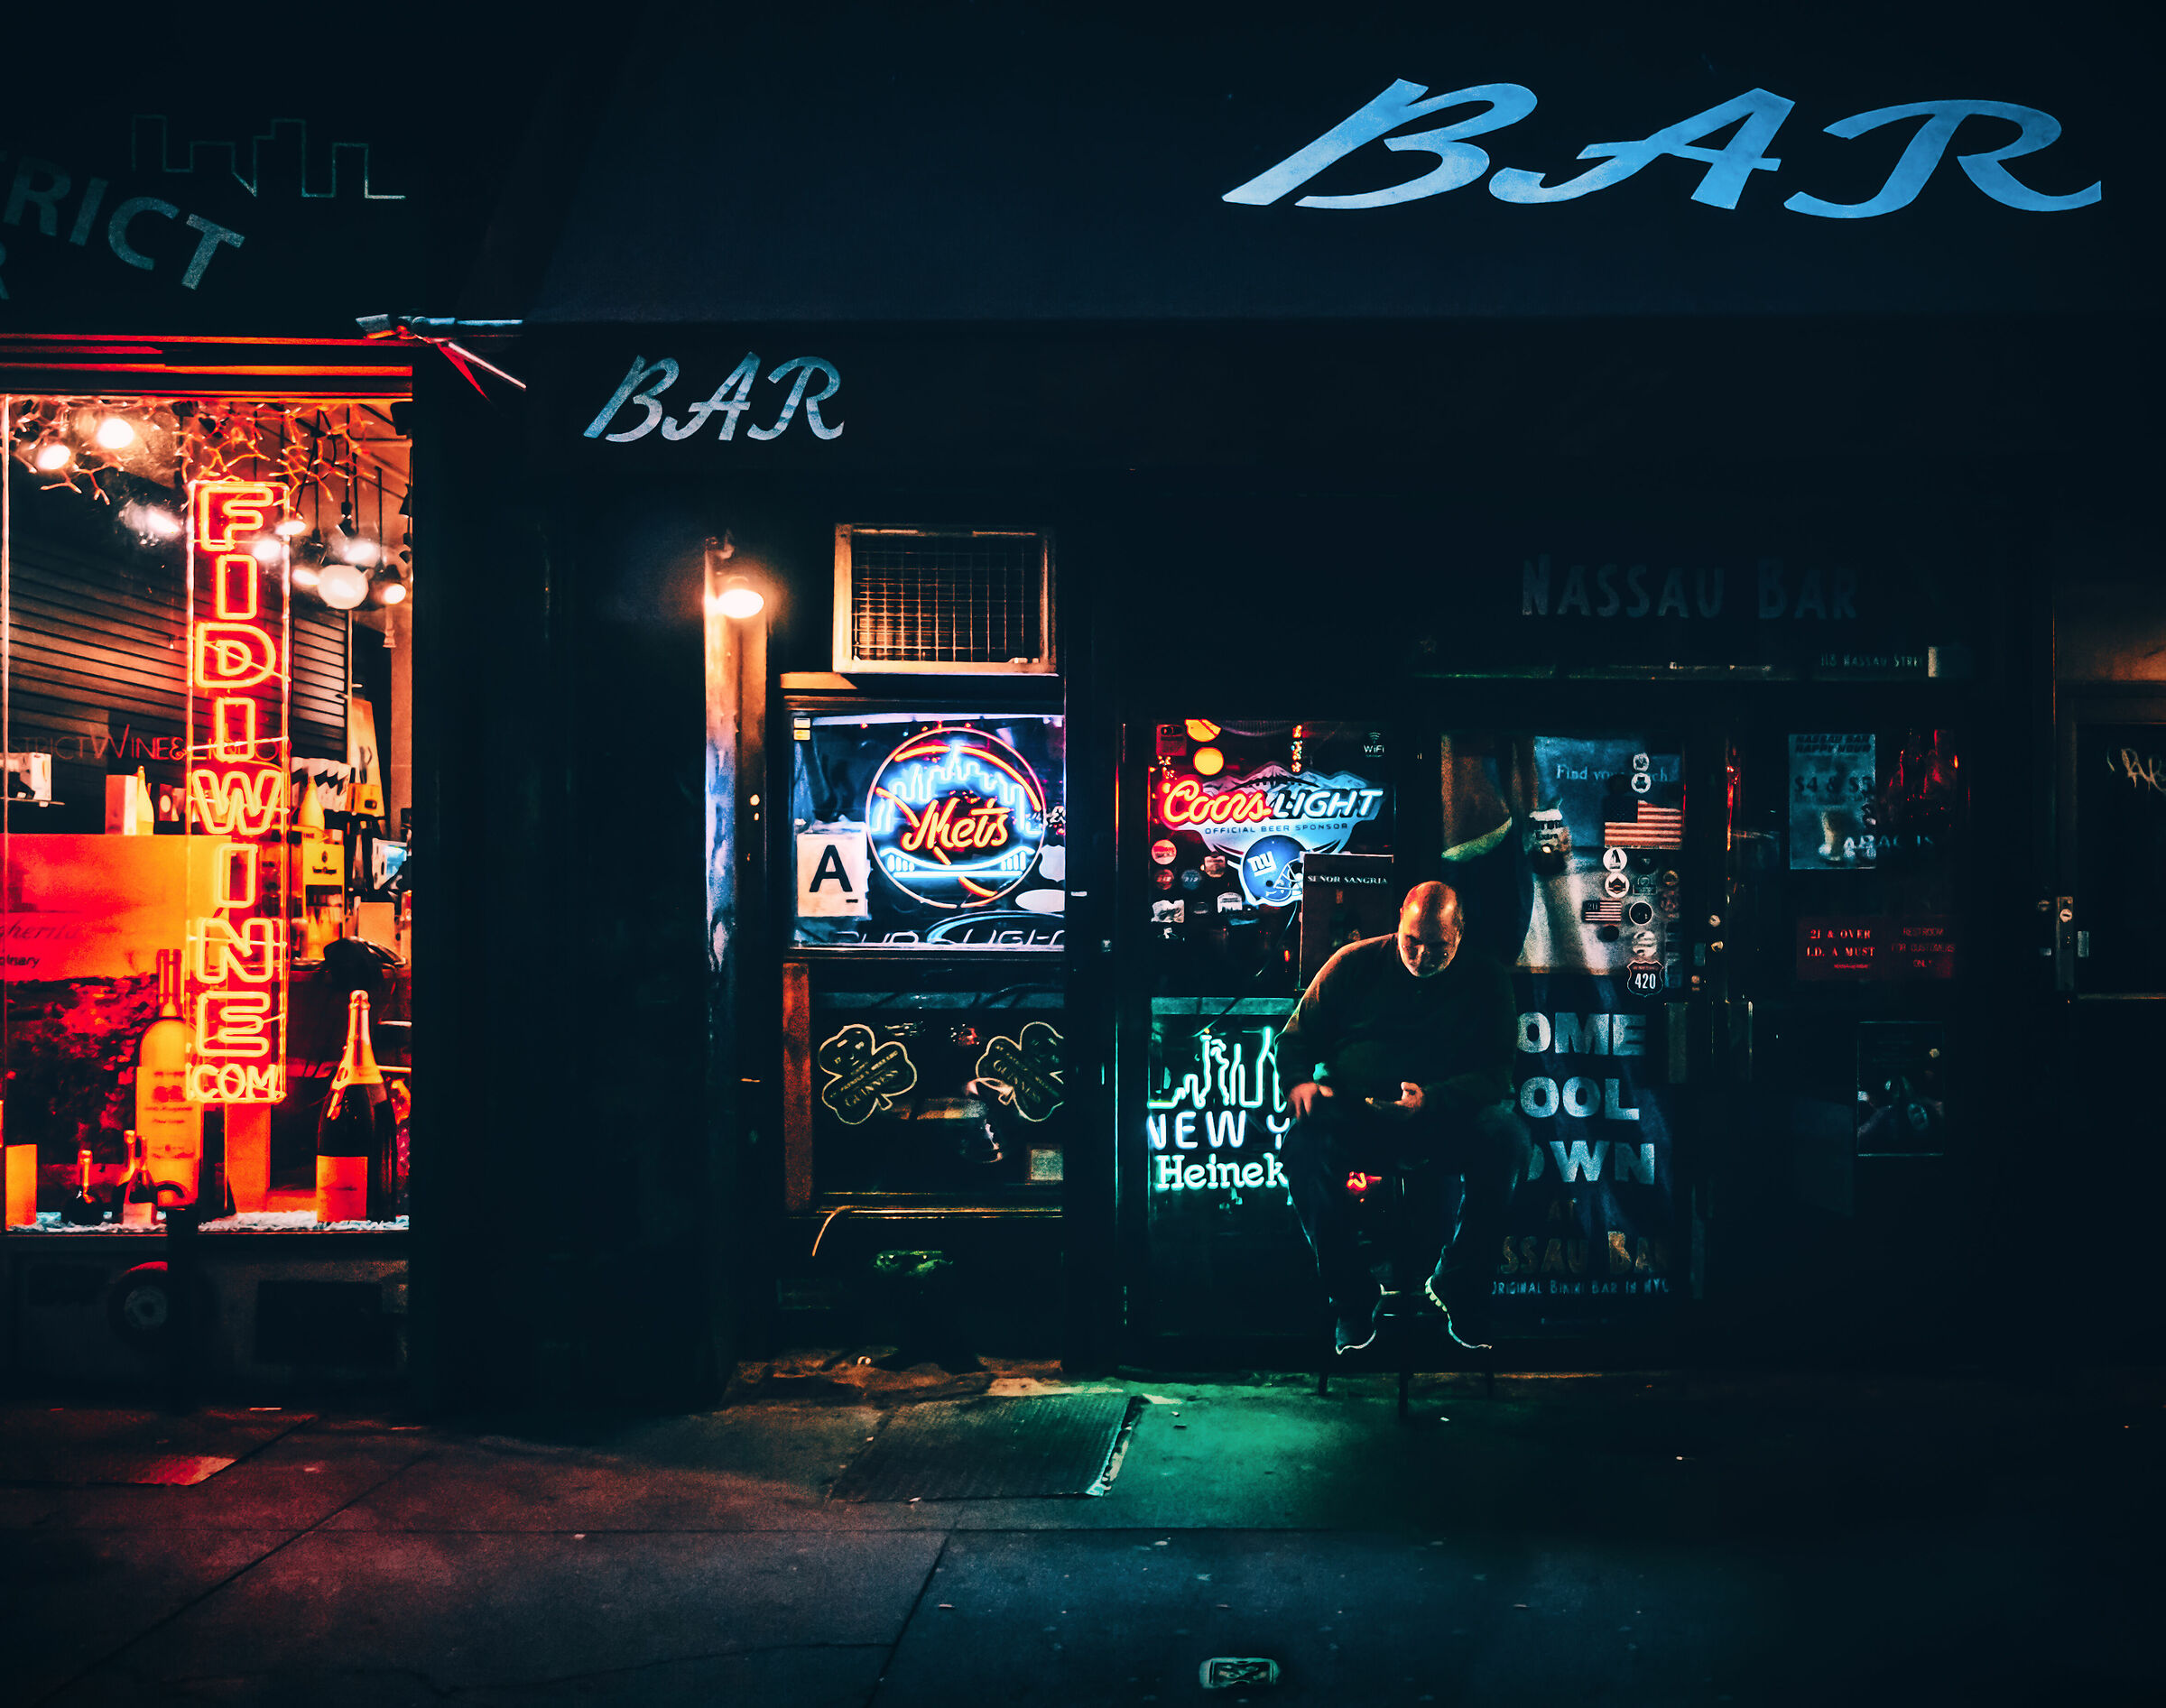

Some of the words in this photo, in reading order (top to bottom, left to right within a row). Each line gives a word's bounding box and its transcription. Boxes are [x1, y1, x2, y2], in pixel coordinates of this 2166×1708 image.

[1222, 78, 2101, 218] BAR
[0, 150, 245, 291] RICT
[583, 353, 844, 443] BAR
[1522, 554, 1725, 617] NASSAU
[1757, 556, 1858, 620] BAR
[1555, 763, 1587, 780] Find
[1163, 780, 1273, 823] Coors
[1271, 789, 1384, 818] LIGHT
[902, 797, 1010, 851] Mets
[1205, 826, 1255, 835] OFFICIAL
[1295, 823, 1347, 831] SPONSOR
[809, 845, 853, 893] A
[1810, 928, 1821, 939] 21
[1827, 929, 1834, 938] &
[1840, 928, 1871, 939] OVER
[1845, 946, 1875, 956] MUST
[1634, 973, 1656, 990] 420
[1517, 1011, 1647, 1057] OME
[1520, 1076, 1641, 1121] OOL
[1147, 1110, 1246, 1149] NEW
[1155, 1152, 1290, 1190] Heinek
